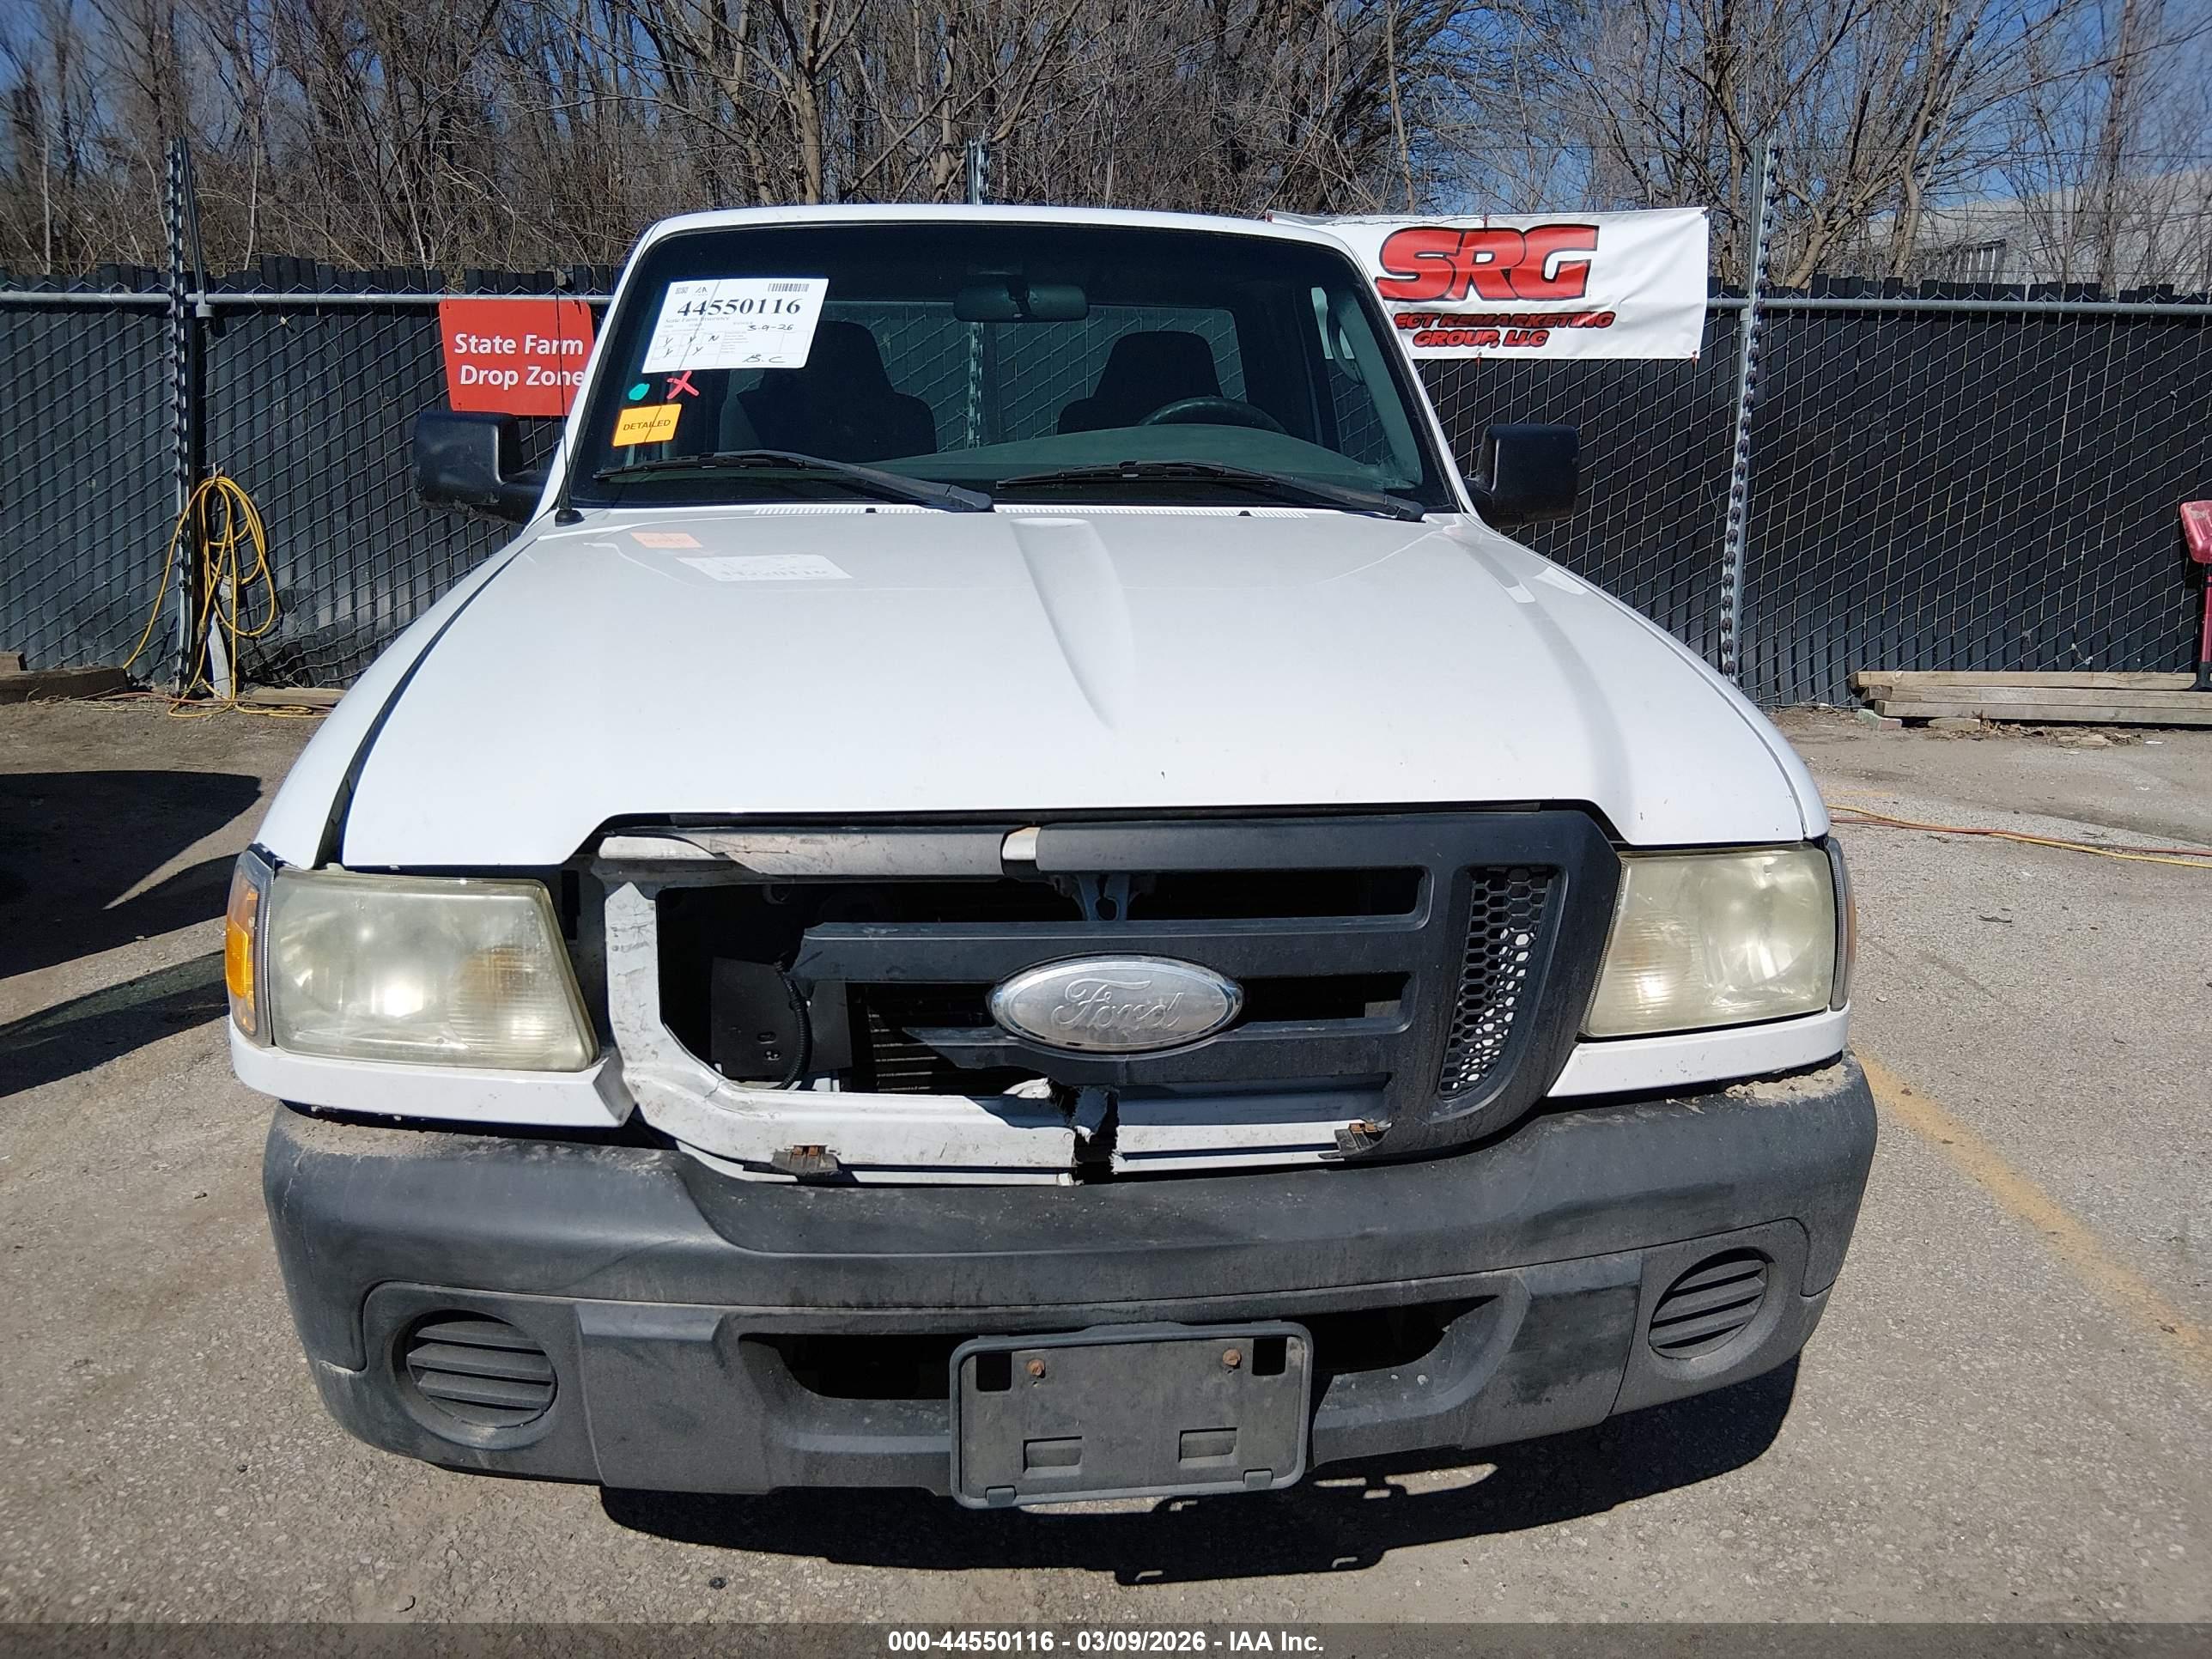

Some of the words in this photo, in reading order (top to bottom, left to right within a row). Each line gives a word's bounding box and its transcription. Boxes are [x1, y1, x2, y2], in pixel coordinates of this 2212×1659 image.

[1375, 223, 1600, 301] SRG
[677, 297, 804, 317] 44550116
[1393, 313, 1442, 330] ECT
[1438, 311, 1616, 330] REMARKETING
[454, 333, 516, 354] State
[524, 334, 584, 356] Farm
[1413, 330, 1501, 349] GROUP,
[1502, 330, 1551, 348] LLC
[459, 365, 520, 391] Drop
[526, 366, 585, 386] Zone
[623, 419, 672, 431] DETAILED
[1051, 977, 1186, 1031] Ford
